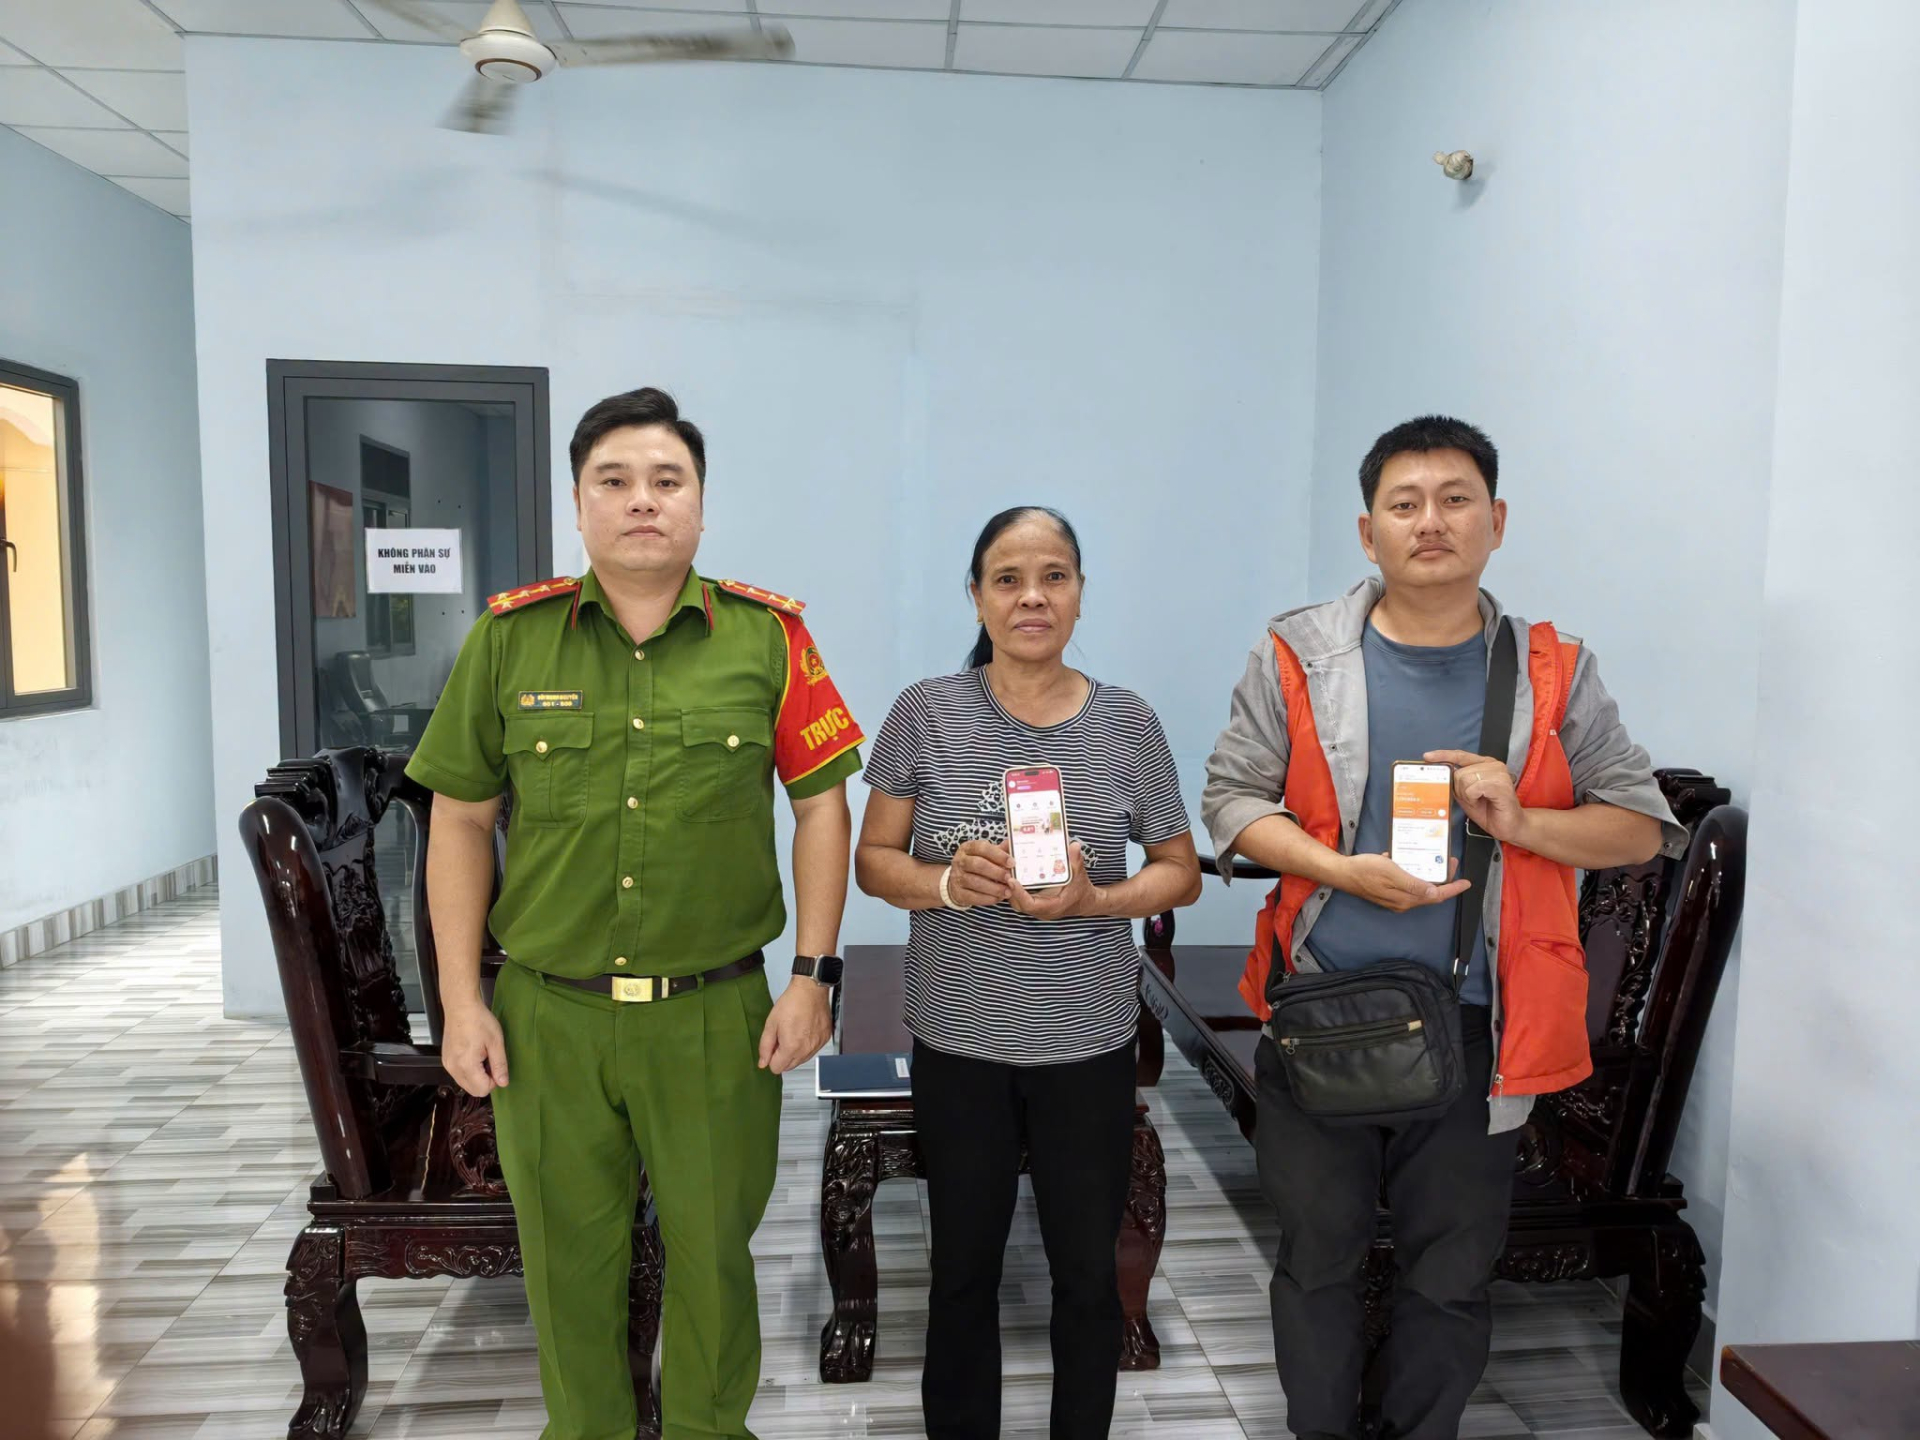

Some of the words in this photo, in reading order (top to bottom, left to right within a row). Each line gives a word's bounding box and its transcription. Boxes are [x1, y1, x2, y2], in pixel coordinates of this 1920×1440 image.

[378, 547, 409, 558] KHÔNG
[438, 547, 451, 560] SỰ
[800, 707, 849, 751] TRỰC
